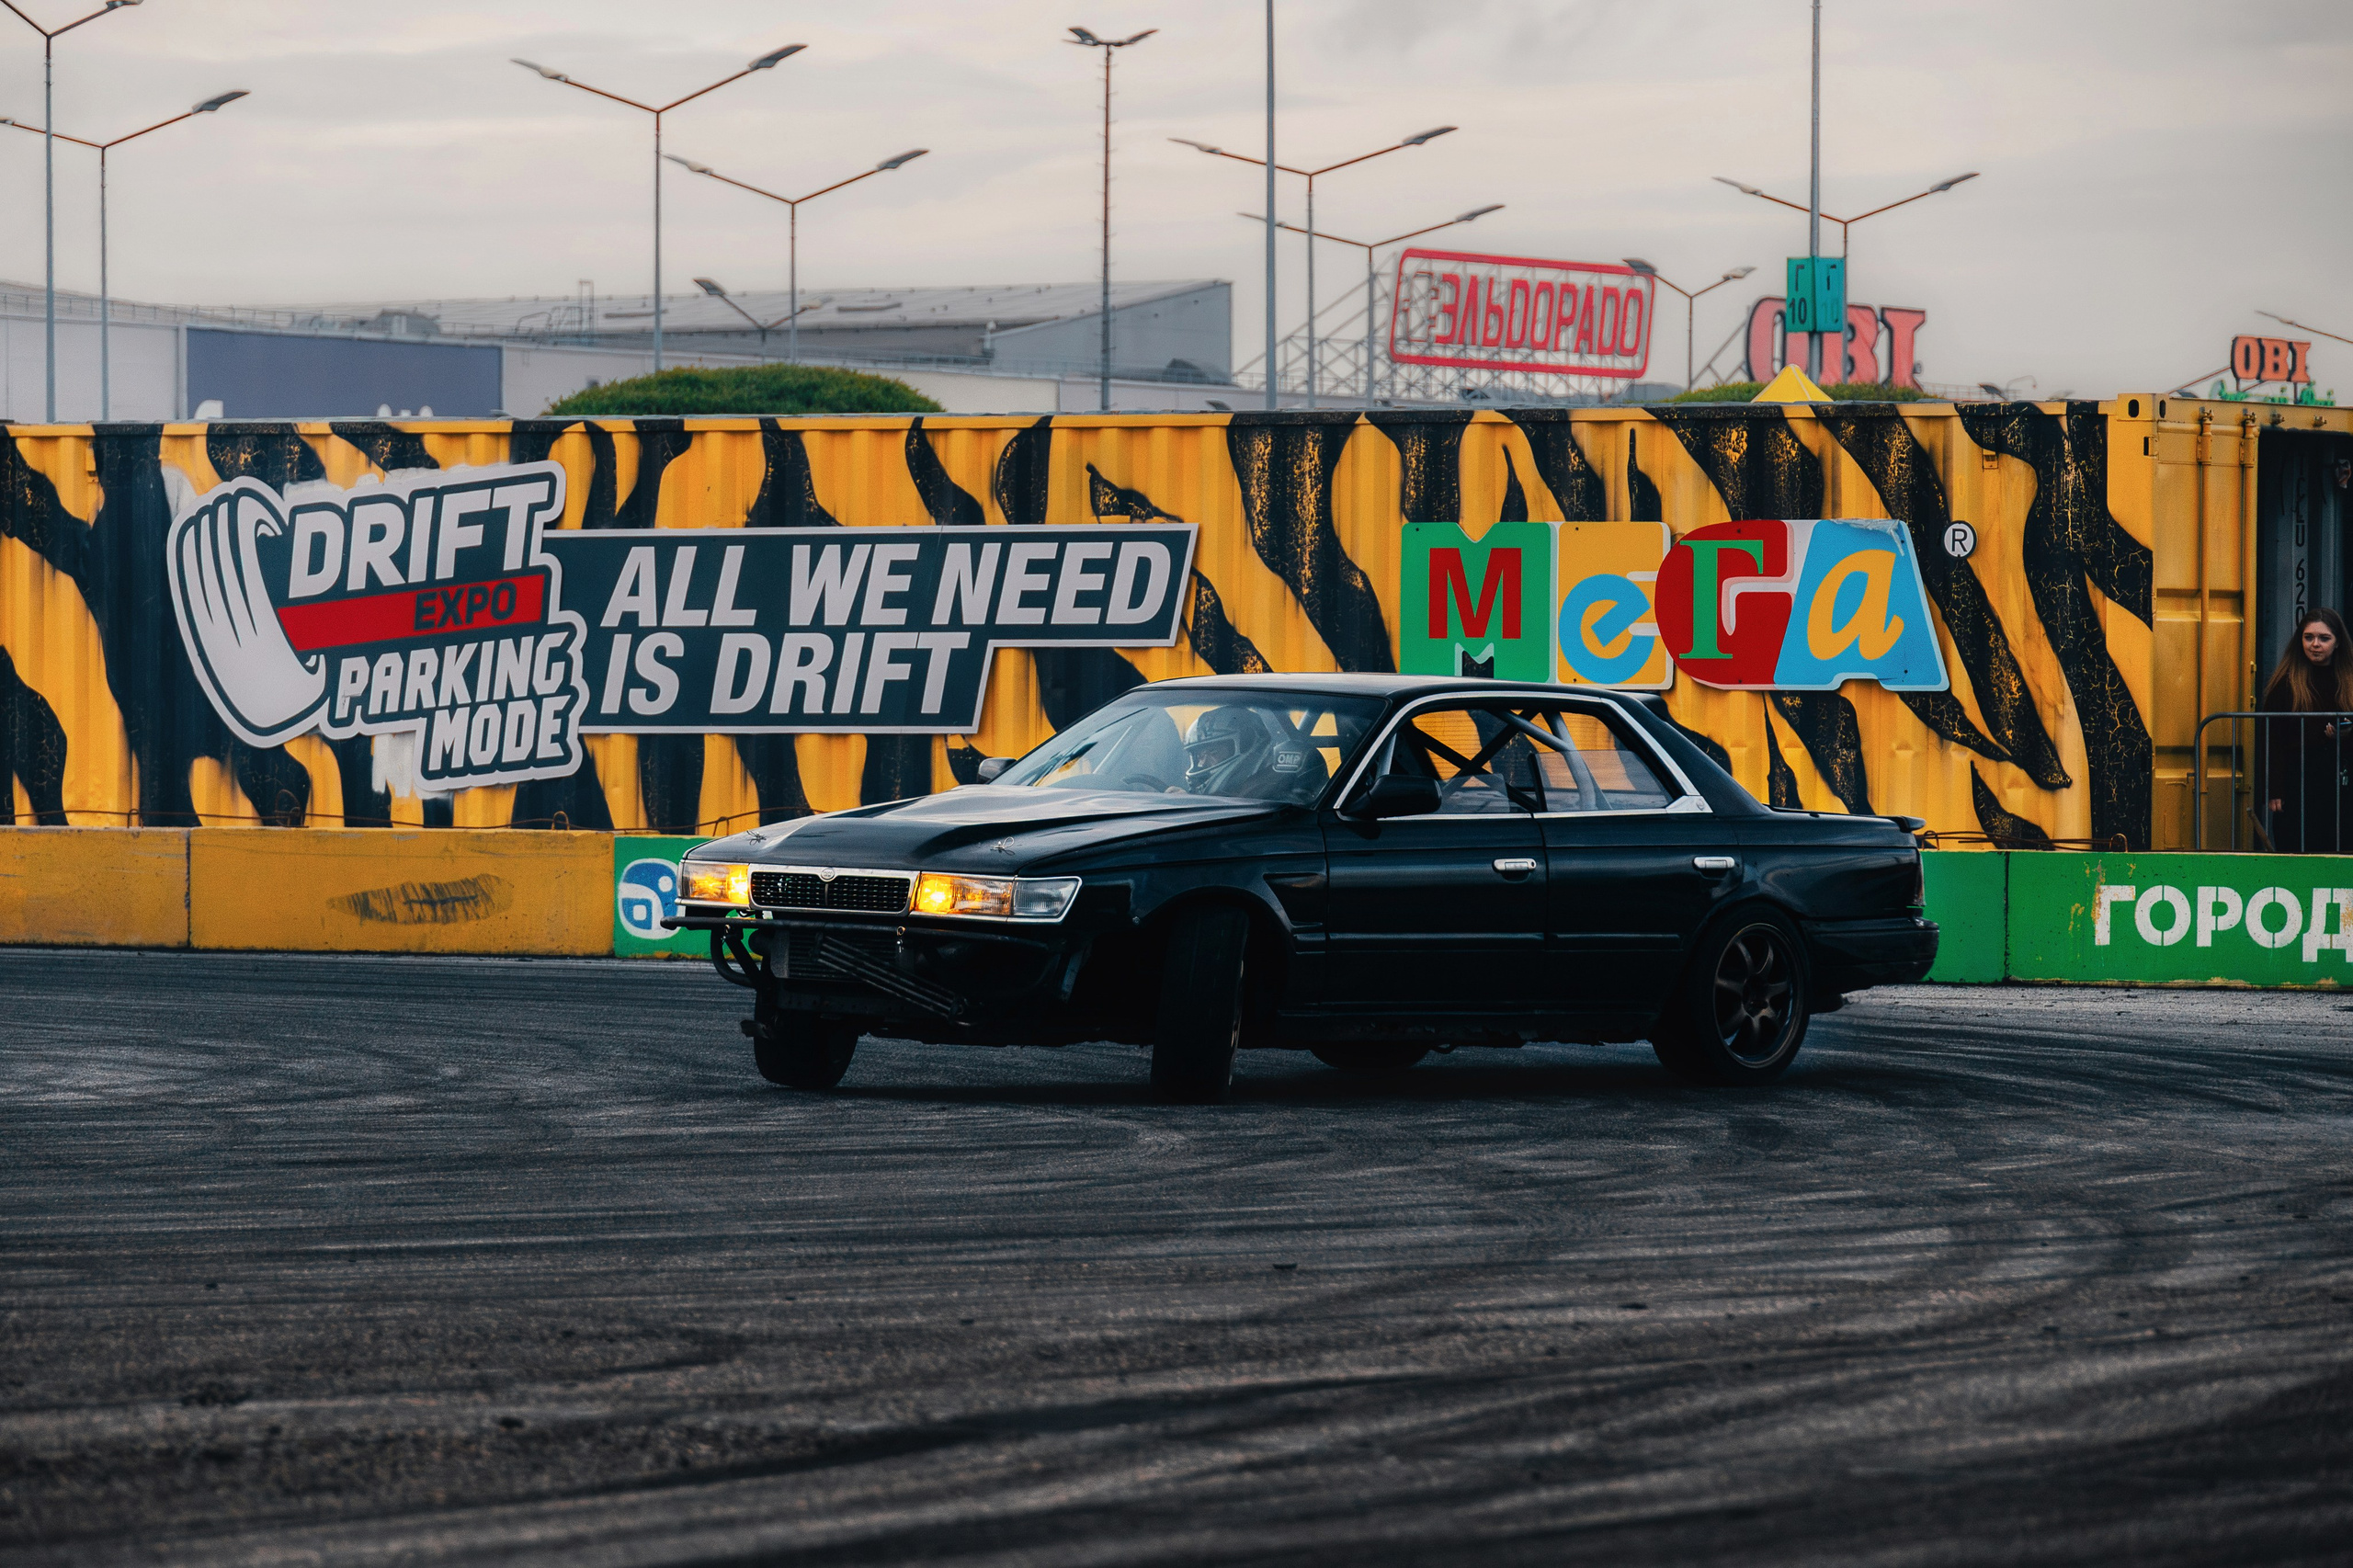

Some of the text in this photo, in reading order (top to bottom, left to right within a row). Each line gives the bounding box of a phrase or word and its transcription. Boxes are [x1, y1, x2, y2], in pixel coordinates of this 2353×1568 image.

[1747, 297, 1927, 392] OBI
[1789, 297, 1808, 324] 10
[2231, 335, 2312, 383] OBI
[289, 481, 550, 598] DRIFT
[413, 581, 517, 631] EXPO
[600, 540, 1173, 627] ALL WE NEED
[334, 632, 570, 721] PARKING
[599, 631, 972, 715] IS DRIFT
[428, 695, 572, 771] MODE
[1278, 754, 1302, 765] OMP
[2095, 885, 2353, 963] ГОРОД
